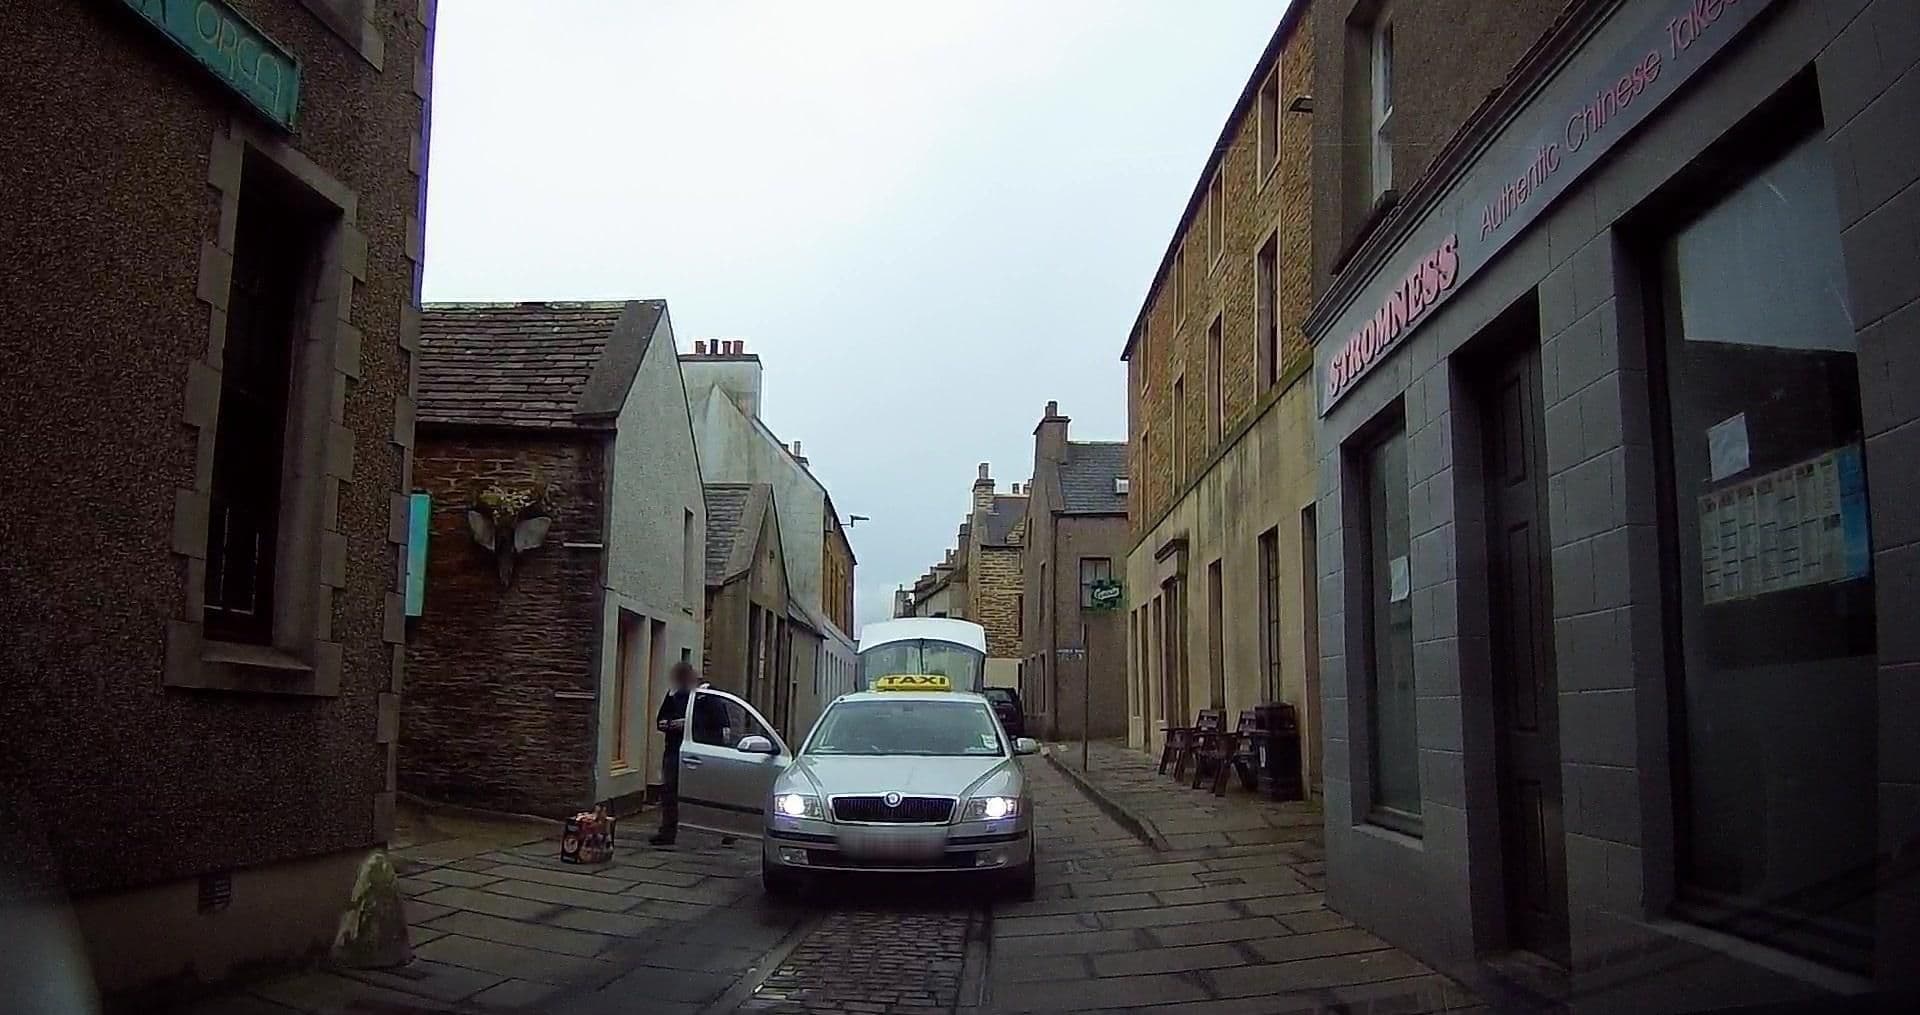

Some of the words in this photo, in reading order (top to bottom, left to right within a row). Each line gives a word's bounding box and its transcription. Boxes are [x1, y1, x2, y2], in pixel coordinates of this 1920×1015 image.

[196, 1, 281, 113] ORCA
[1328, 233, 1460, 398] STROMNESS
[1480, 141, 1561, 241] Authentic
[1565, 49, 1662, 153] Chinese
[1665, 0, 1738, 60] Take
[885, 676, 946, 685] TAXI
